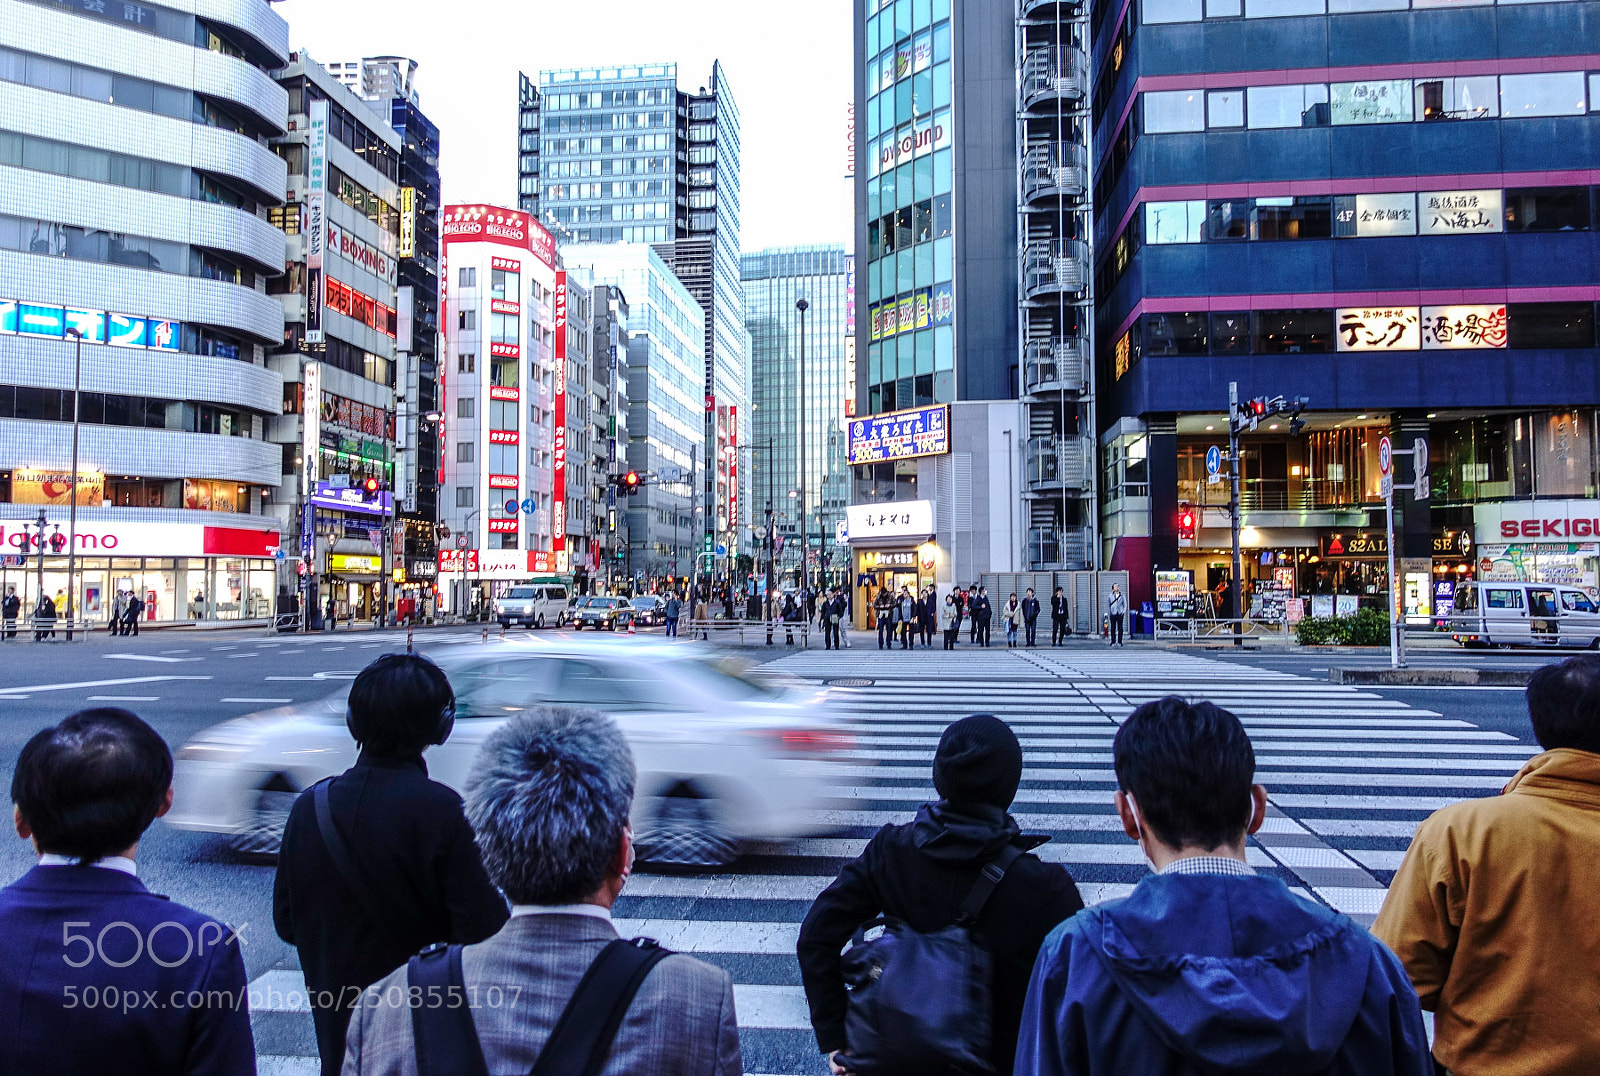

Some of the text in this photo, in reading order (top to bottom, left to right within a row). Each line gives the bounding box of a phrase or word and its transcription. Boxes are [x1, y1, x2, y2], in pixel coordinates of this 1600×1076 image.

[444, 212, 481, 222] カラオケ
[487, 213, 523, 227] カラオケ
[1336, 210, 1354, 222] 4F
[1431, 211, 1491, 229] 八海山
[444, 223, 482, 235] BIG ECHO
[486, 224, 524, 240] BIG ECHO
[341, 236, 387, 275] BOXING
[493, 258, 520, 269] カラオケ
[556, 283, 566, 328] カラオケ
[1339, 314, 1483, 347] テング 酒場
[492, 344, 519, 355] カラオケ
[491, 432, 518, 442] カラオケ
[555, 426, 565, 470] カラオケ
[490, 522, 517, 530] カラオケ
[1501, 519, 1600, 538] SEKIG
